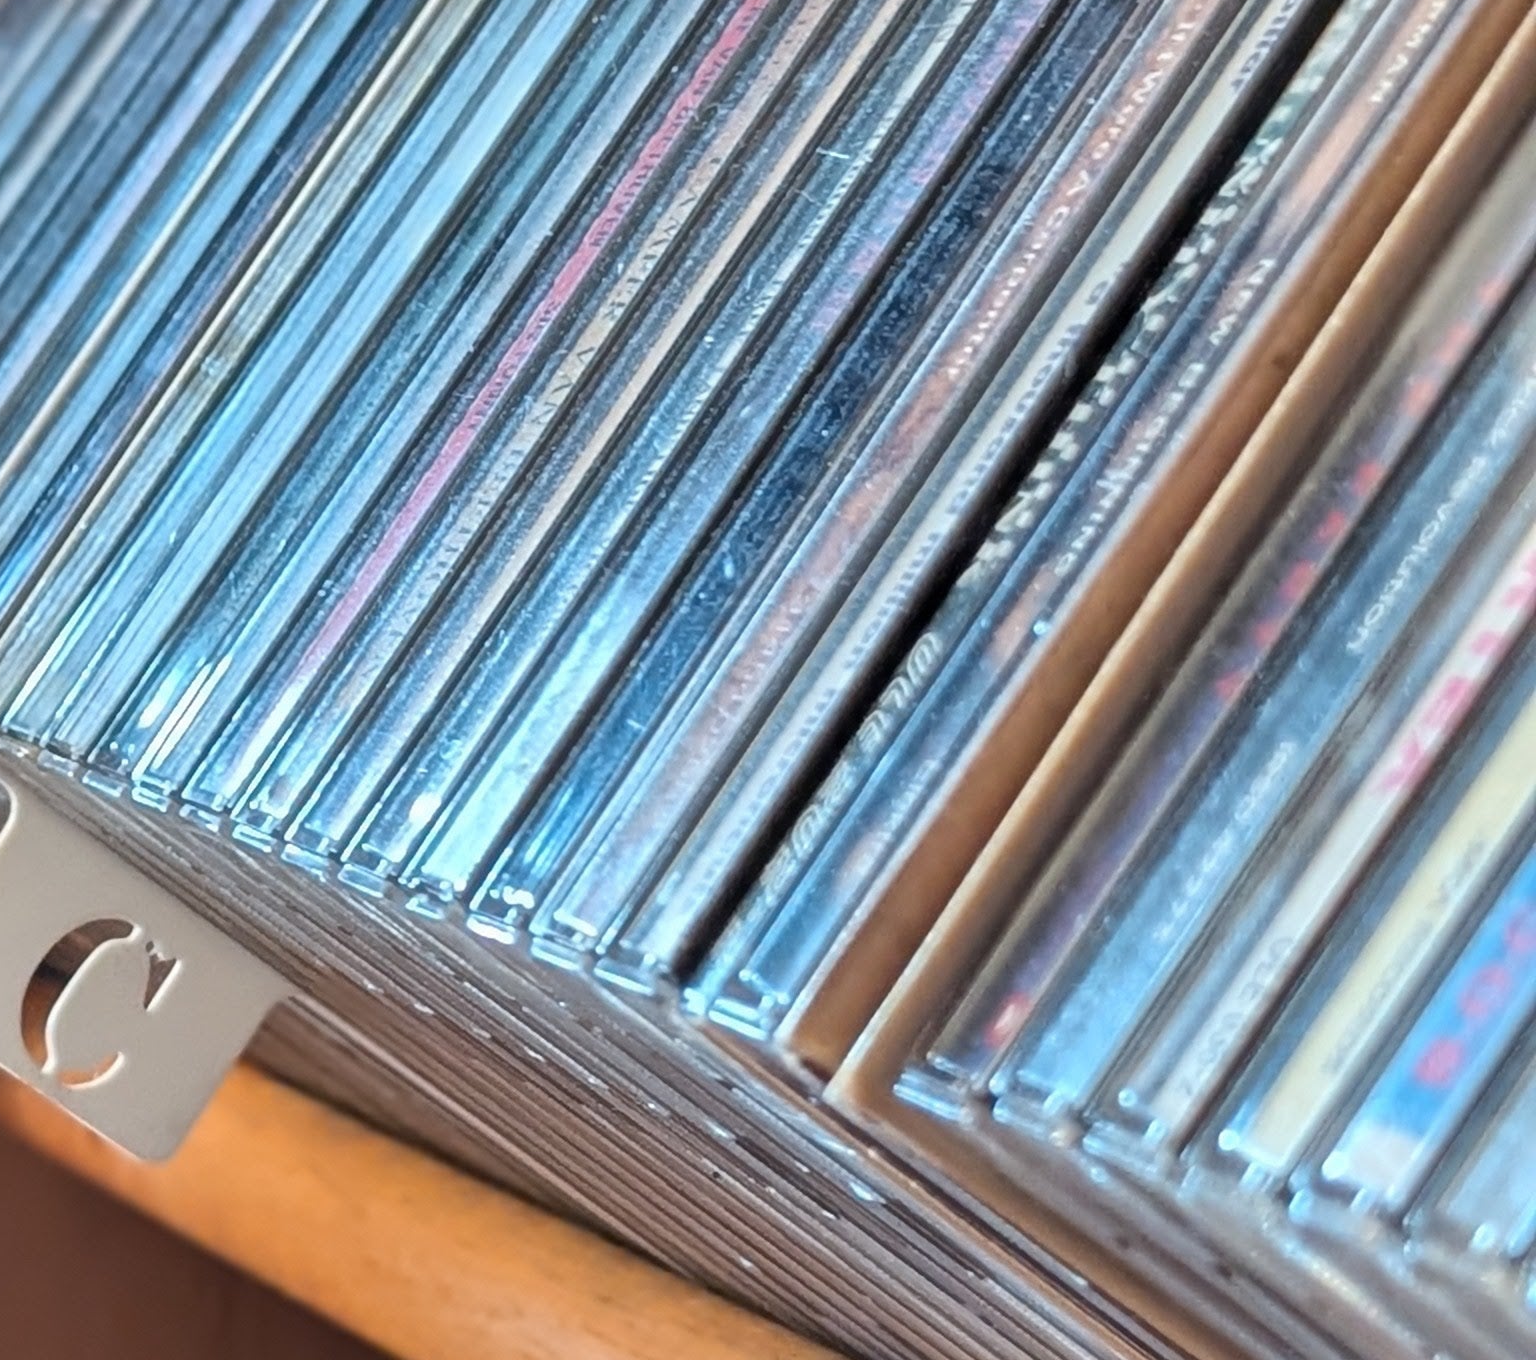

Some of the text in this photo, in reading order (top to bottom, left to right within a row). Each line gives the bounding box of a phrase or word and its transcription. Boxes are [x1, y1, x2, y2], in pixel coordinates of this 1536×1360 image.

[943, 199, 1071, 382] Carpenter
[1205, 253, 1279, 349] NEW
[945, 317, 1087, 519] thousand
[1050, 357, 1208, 581] BEGINNING
[841, 527, 945, 676] million
[1342, 451, 1488, 656] Revolution
[20, 917, 183, 1091] C
